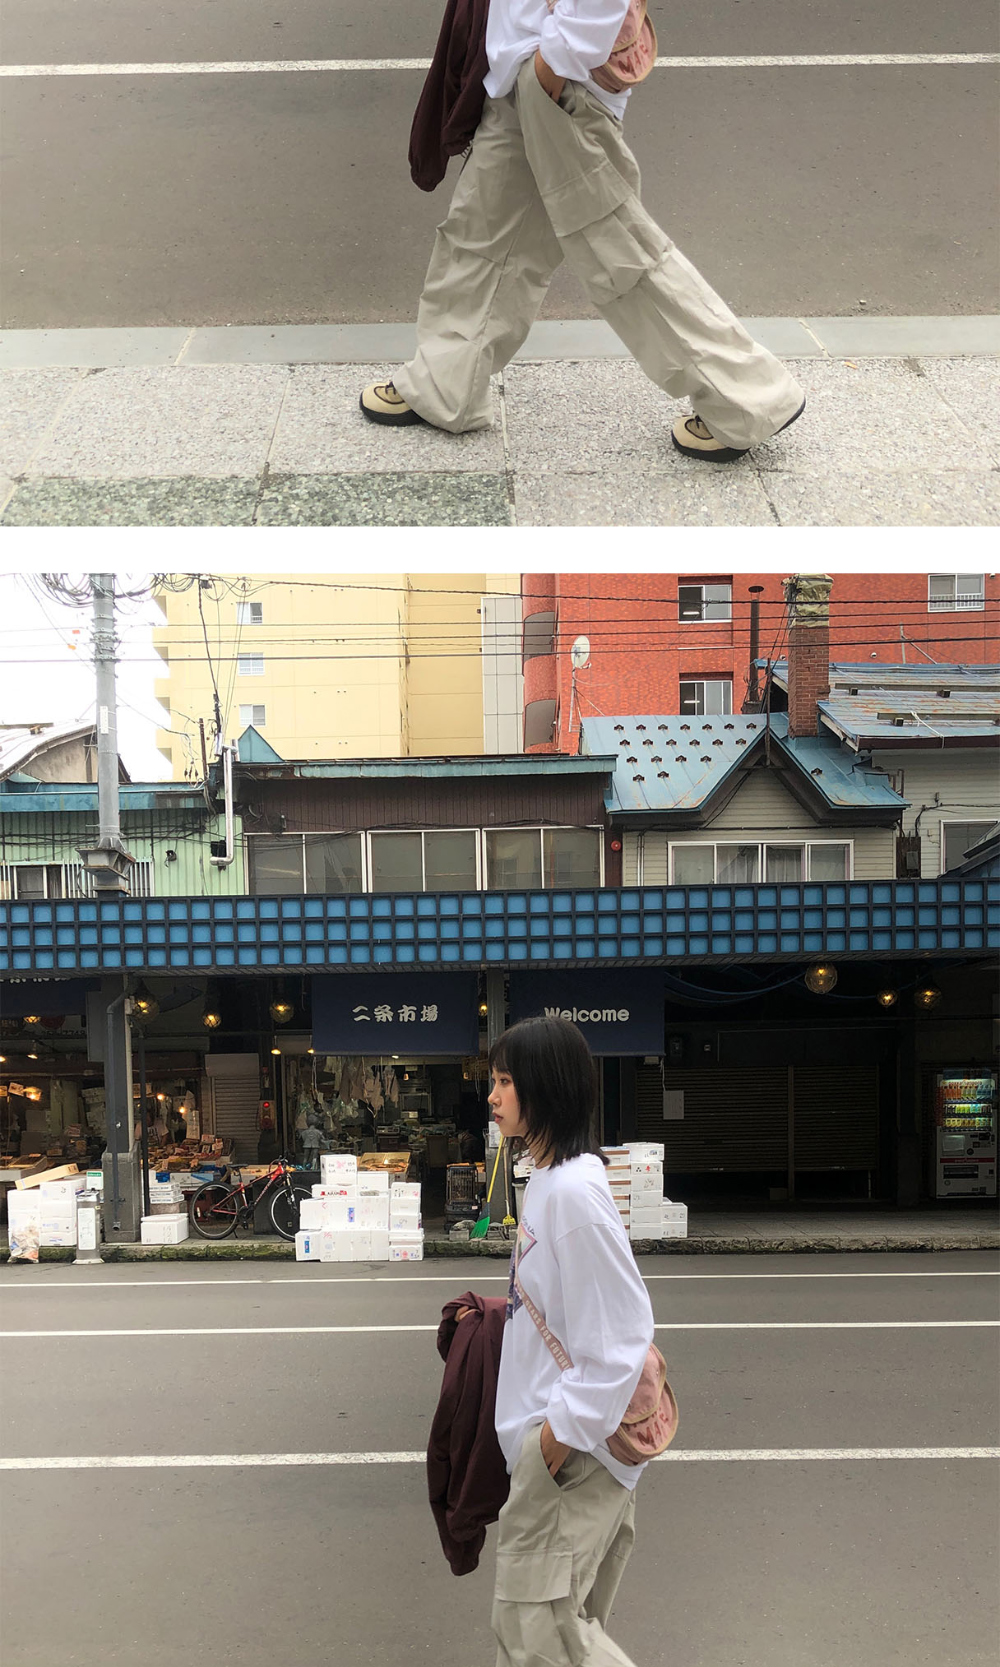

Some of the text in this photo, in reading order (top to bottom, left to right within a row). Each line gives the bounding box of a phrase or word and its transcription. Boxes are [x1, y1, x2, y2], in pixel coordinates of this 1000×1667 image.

[352, 1004, 439, 1023] 二条市場
[544, 1005, 630, 1023] Welcome
[540, 1326, 552, 1342] FOR
